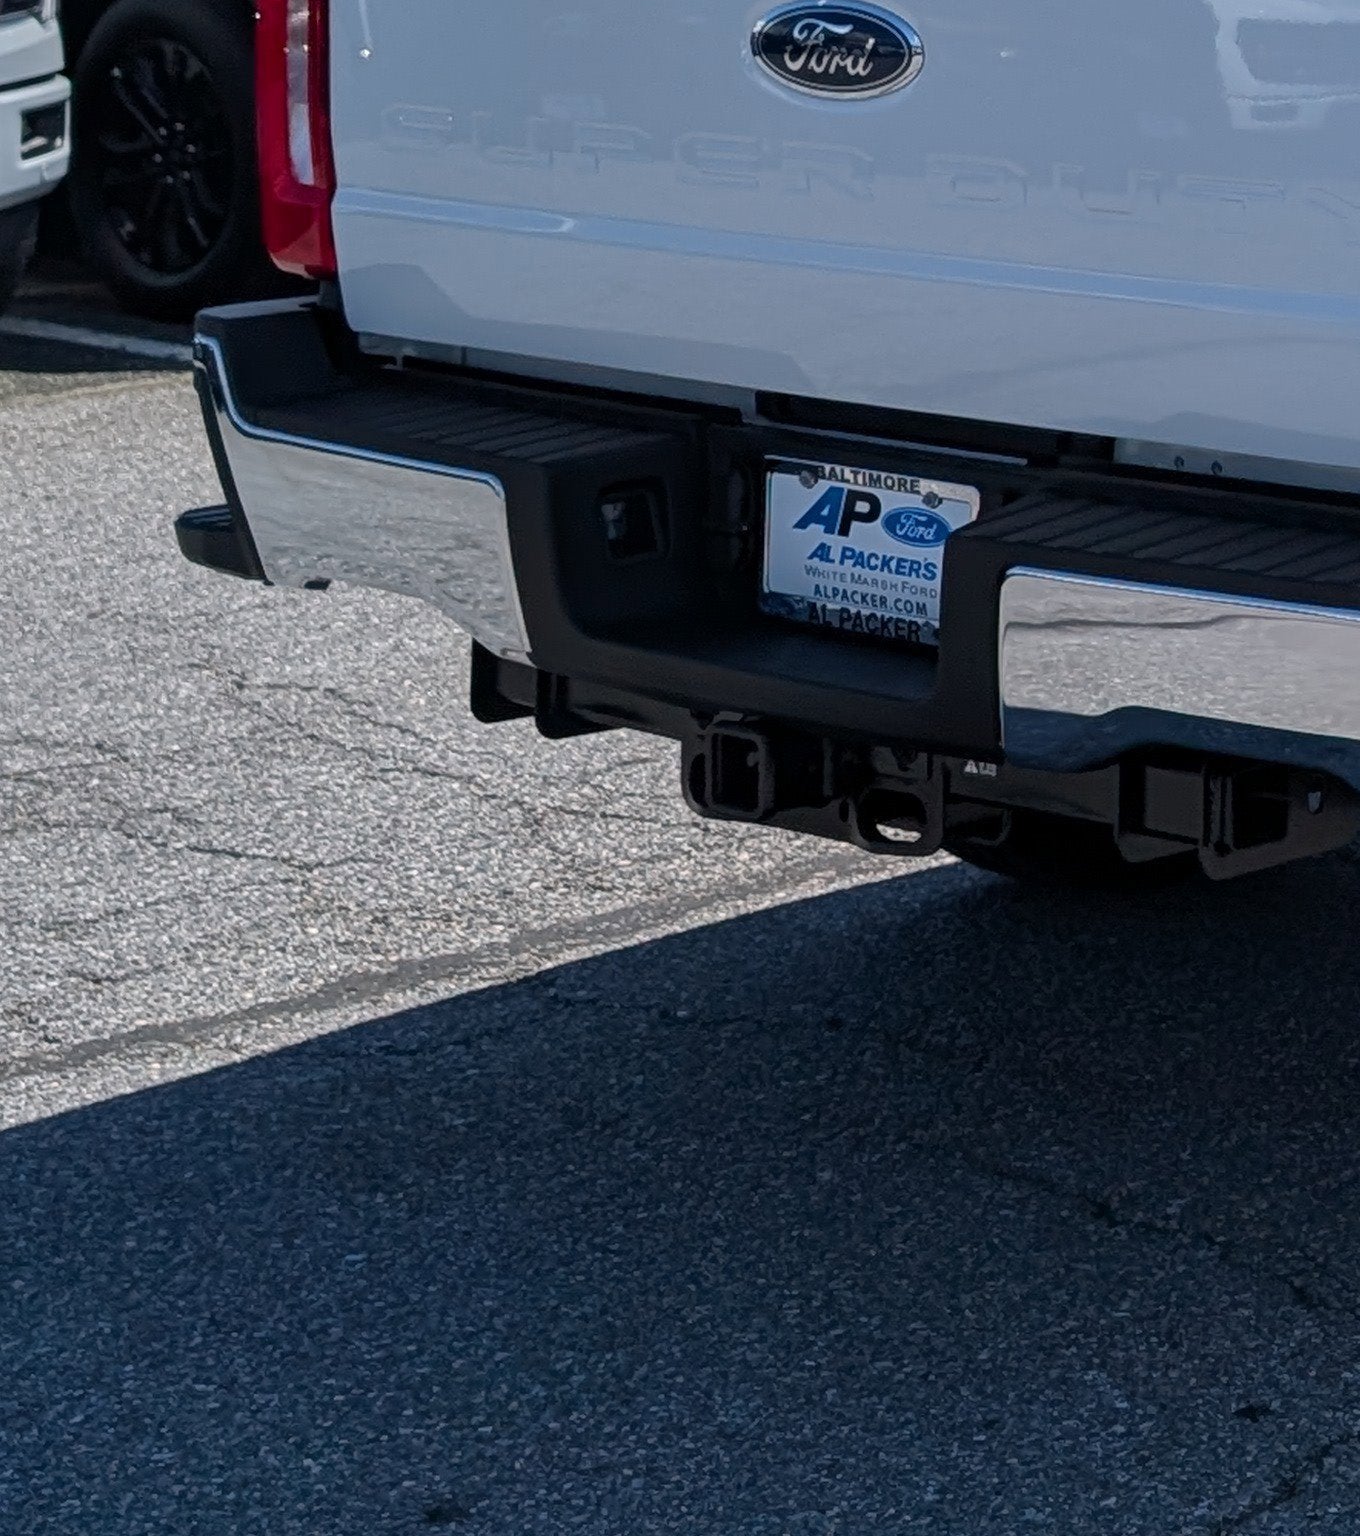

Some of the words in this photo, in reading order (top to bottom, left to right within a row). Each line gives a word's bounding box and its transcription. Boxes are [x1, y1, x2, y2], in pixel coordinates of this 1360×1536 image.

[784, 18, 875, 76] Ford
[381, 102, 875, 201] SUPER
[816, 465, 921, 495] BALTIMORE
[793, 486, 881, 537] AP
[896, 513, 938, 540] Ford
[807, 542, 835, 564] AL
[839, 546, 938, 581] PACKER'S
[804, 564, 847, 583] WHITE
[850, 572, 898, 591] MARSH
[901, 581, 938, 599] FORD
[814, 584, 928, 616] ALPACKER.COM
[807, 601, 833, 626] AL
[839, 607, 921, 642] PACKER
